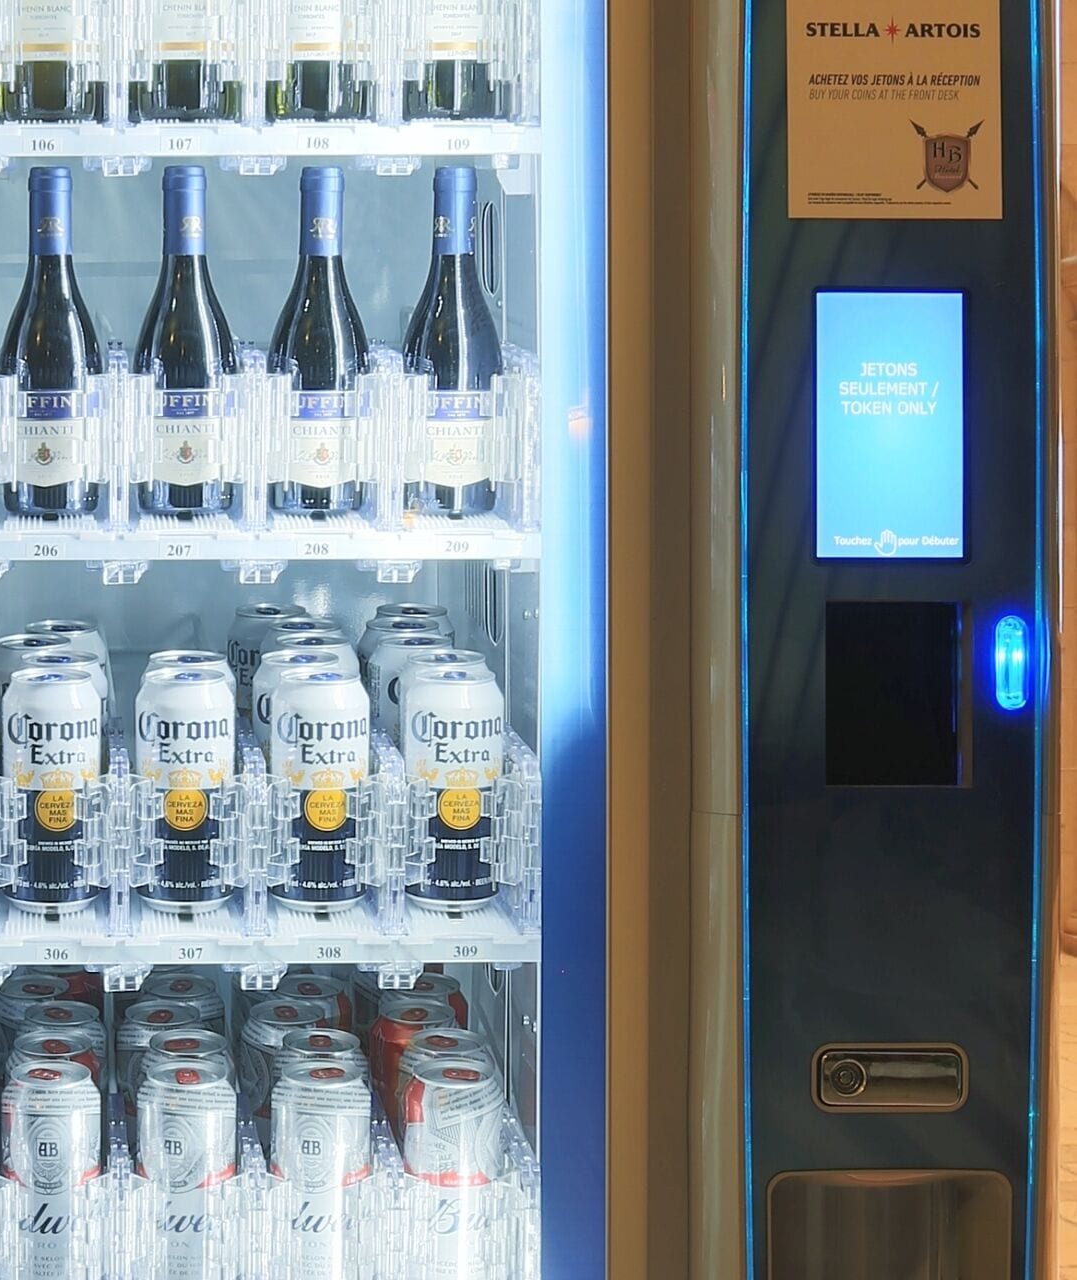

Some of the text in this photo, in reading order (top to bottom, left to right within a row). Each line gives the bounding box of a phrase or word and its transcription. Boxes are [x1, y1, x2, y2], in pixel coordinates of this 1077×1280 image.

[806, 22, 981, 38] STELLA ARTOIS
[808, 73, 849, 86] ACHETEZ
[851, 74, 869, 86] VOS
[871, 74, 905, 86] JETONS
[916, 74, 928, 86] LA
[930, 72, 981, 87] RÉCEPTION
[809, 89, 959, 100] BUY YOUR COINS AT THE FRONT DESK
[32, 139, 55, 151] 106
[168, 138, 192, 151] 107
[307, 137, 329, 149] 108
[448, 139, 470, 151] 109
[860, 363, 918, 376] JETONS
[839, 382, 928, 396] SEULEMENT
[841, 401, 937, 415] TOKEN ONLY
[445, 540, 470, 553] 209
[833, 535, 960, 548] Touchez pour Débuter
[34, 544, 58, 557] 206
[167, 544, 191, 557] 207
[305, 543, 329, 555] 208
[7, 712, 98, 749] Corona
[139, 710, 230, 747] Corona
[277, 711, 368, 749] Corona
[412, 710, 503, 748] Corona
[30, 744, 85, 766] Extra
[159, 743, 214, 764] Extra
[300, 743, 356, 764] Extra
[434, 742, 490, 764] Extra
[44, 948, 68, 960] 306
[179, 947, 203, 960] 307
[318, 947, 341, 960] 308
[453, 945, 478, 958] 309
